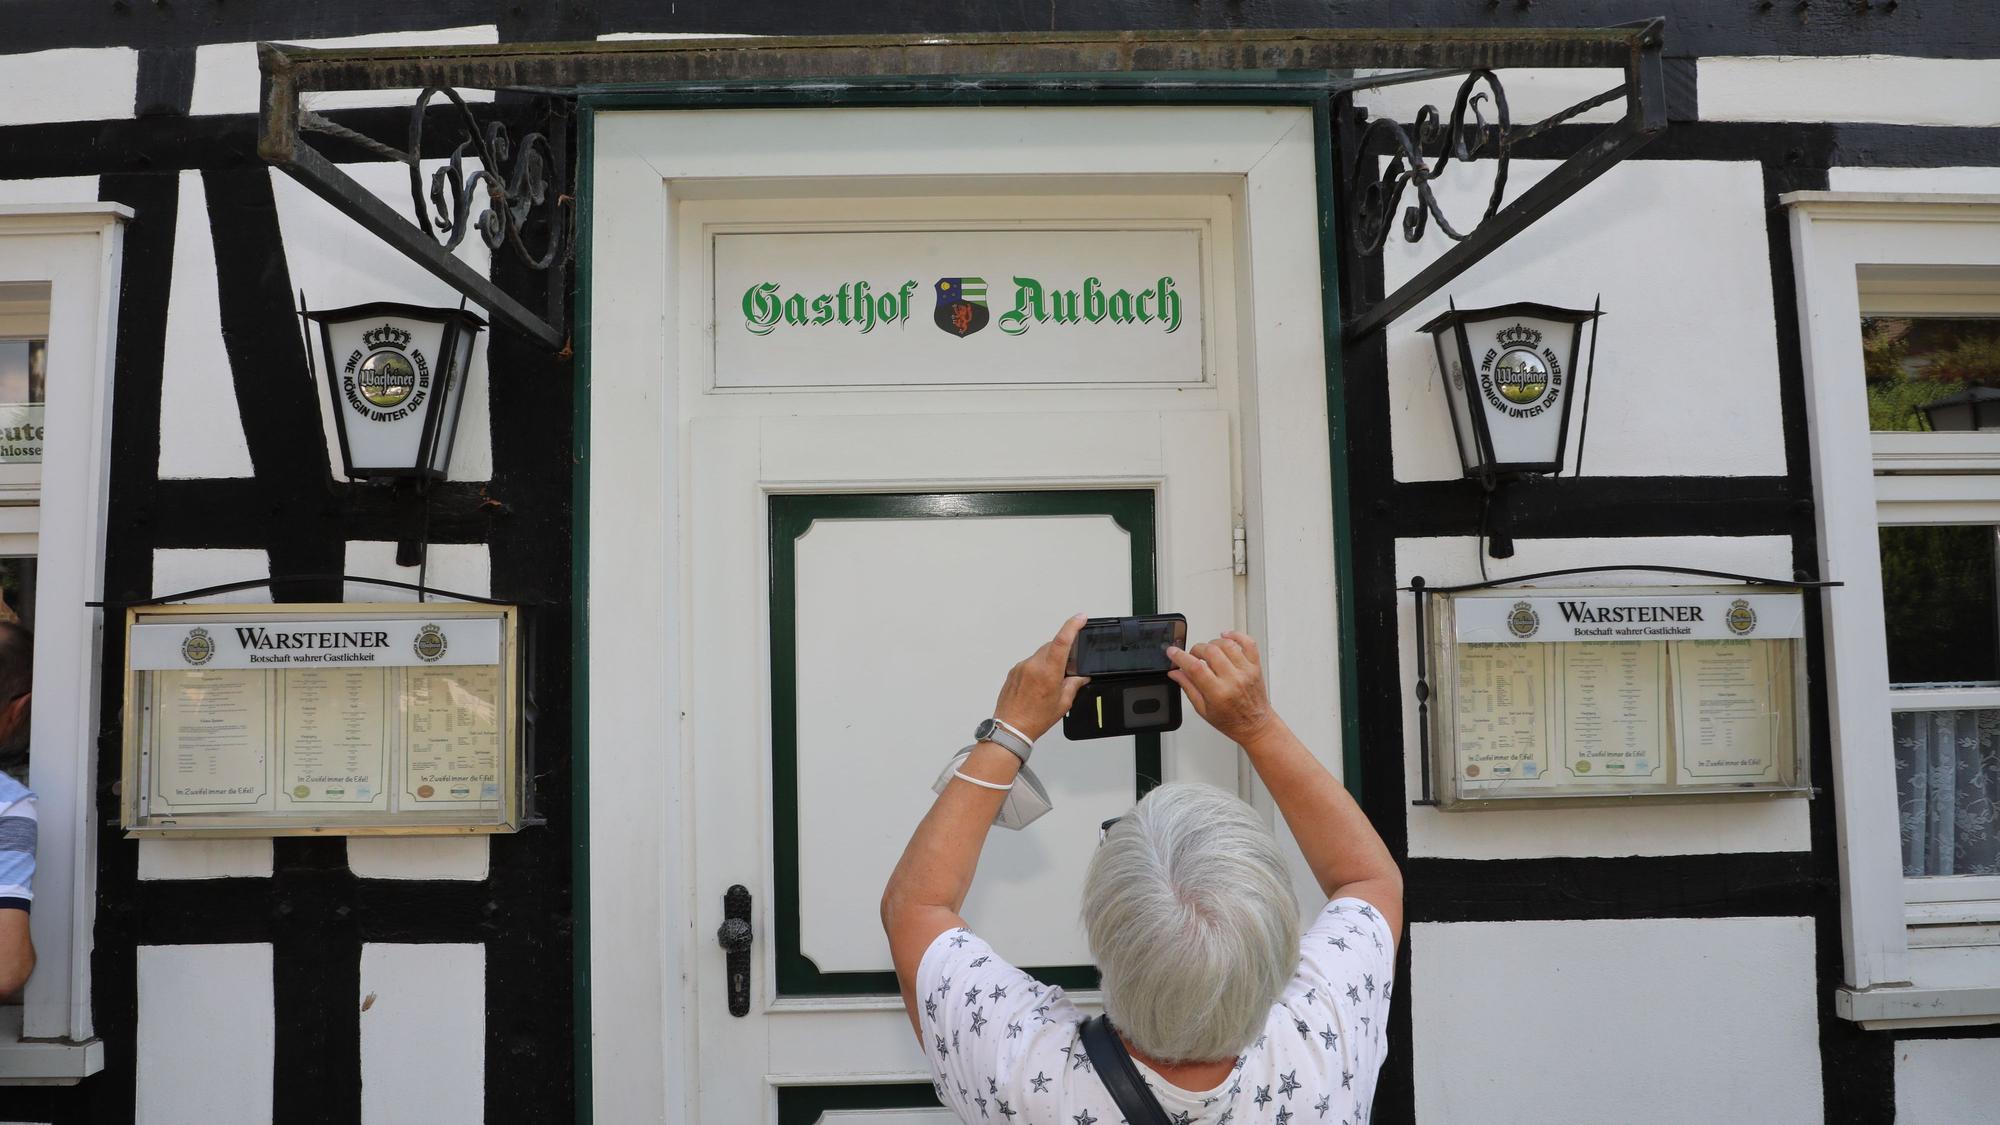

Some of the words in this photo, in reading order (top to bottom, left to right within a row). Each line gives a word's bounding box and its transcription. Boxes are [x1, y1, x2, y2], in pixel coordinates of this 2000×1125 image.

[741, 279, 919, 336] Gasthof
[998, 275, 1184, 336] Aubach
[345, 349, 363, 374] EINE
[411, 349, 429, 387] BIEREN
[1482, 349, 1497, 371] EINE
[1543, 348, 1561, 385] BIEREN
[344, 376, 369, 416] KÖNIGIN
[409, 391, 426, 410] DEN
[1481, 374, 1507, 413] KÖNIGIN
[1544, 389, 1560, 408] DEN
[371, 409, 408, 421] UNTER
[1509, 405, 1543, 418] UNTER
[1574, 627, 1613, 636] Botschaft
[1615, 628, 1643, 636] wahrer
[1643, 626, 1692, 635] Gastlichkeit
[250, 653, 290, 663] Botschaft
[293, 653, 323, 662] wahrer
[323, 652, 375, 662] Gastlichkeit
